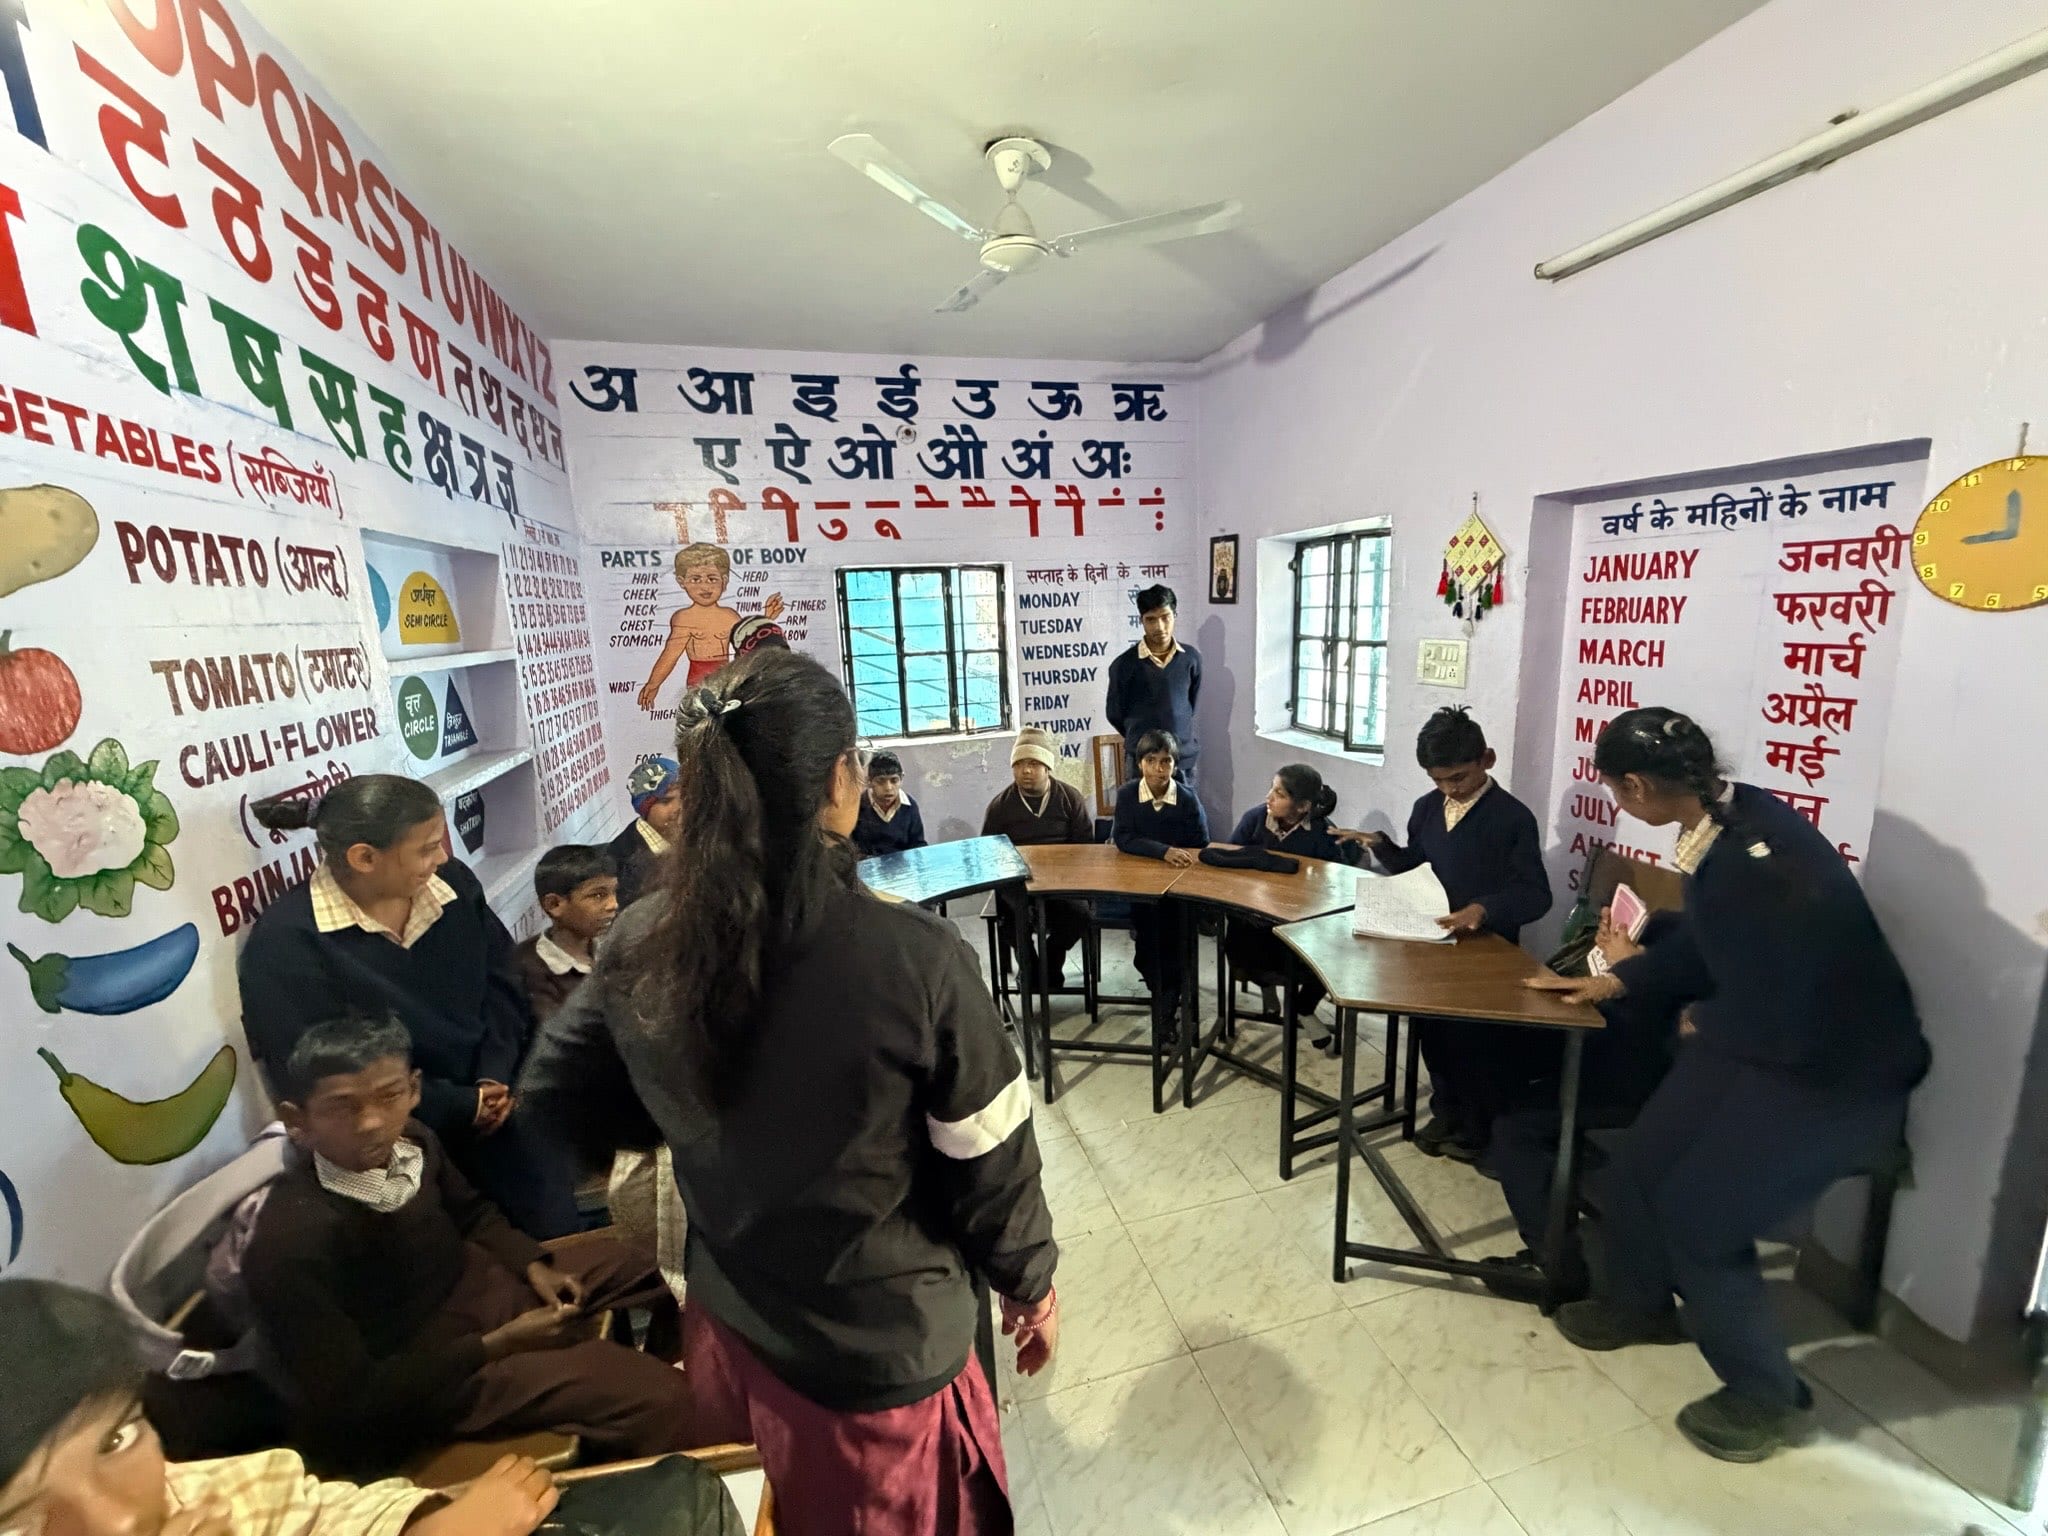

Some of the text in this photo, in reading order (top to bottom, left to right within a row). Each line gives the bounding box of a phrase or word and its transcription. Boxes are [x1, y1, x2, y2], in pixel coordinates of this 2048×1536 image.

[72, 41, 188, 229] ट
[192, 138, 273, 284] ठ
[280, 208, 343, 331] ड
[397, 302, 447, 399] ण
[447, 341, 480, 419] त
[76, 223, 203, 398] श
[207, 296, 295, 431] ष
[298, 345, 368, 463] स
[367, 382, 414, 484] ह
[418, 411, 460, 500] क्ष
[459, 433, 492, 505] त्र
[569, 363, 1168, 425] अ आ इ ई उ ऊ ऋ
[693, 423, 1132, 486] ए ऐ ओ औ अं अः
[2007, 459, 2026, 472] 12
[1963, 475, 1981, 487] 11
[1602, 503, 1643, 535] वर्ष
[1650, 499, 1678, 530] के
[1779, 484, 1811, 518] के
[1819, 481, 1896, 513] नाम
[1931, 500, 1950, 512] 10
[1915, 534, 1926, 545] 9
[114, 521, 269, 588] POTATO
[502, 542, 508, 568] 1
[510, 543, 519, 568] 11
[519, 545, 529, 571] 21
[601, 548, 807, 568] PARTS OF BODY
[1779, 524, 1911, 577] जनवरी
[742, 571, 769, 582] HEAD
[1067, 564, 1078, 583] के
[1117, 562, 1130, 579] के
[1140, 564, 1169, 579] नाम
[1583, 549, 1700, 583] JANUARY
[1923, 567, 1934, 578] 8
[506, 573, 512, 598] 2
[514, 573, 523, 597] 12
[523, 575, 533, 596] 22
[632, 573, 659, 585] HAIR
[623, 588, 658, 601] CHEEK
[736, 587, 760, 598] CHIN
[1019, 591, 1081, 609] MONDAY
[1953, 585, 1963, 596] 7
[1986, 595, 1998, 607] 6
[2034, 587, 2046, 600] 5
[624, 604, 657, 617] NECK
[736, 601, 762, 613] THUMB
[790, 599, 827, 612] FINGERS
[1580, 596, 1688, 625] FEBRUARY
[1773, 579, 1896, 634] फरवरी
[424, 614, 448, 628] CIRCLE
[511, 604, 517, 629] 3
[519, 604, 527, 629] 13
[528, 604, 537, 629] 23
[620, 619, 655, 632] CHEST
[785, 615, 807, 626] ARM
[1020, 618, 1083, 635] TUESDAY
[517, 635, 523, 660] 4
[524, 633, 533, 660] 14
[533, 632, 542, 657] 24
[609, 634, 663, 648] STOMACH
[1021, 641, 1108, 660] WEDNESDAY
[1579, 639, 1665, 668] MARCH
[1783, 632, 1866, 679] मार्च
[150, 651, 296, 716] TOMATO
[522, 665, 529, 690] 5
[529, 664, 537, 688] 15
[537, 663, 546, 686] 25
[1022, 667, 1098, 686] THURSDAY
[609, 681, 637, 694] WRIST
[1577, 678, 1640, 708] APRIL
[526, 690, 551, 720] 6 16 26
[1025, 694, 1070, 711] FRIDAY
[1762, 683, 1858, 735] अप्रैल
[404, 715, 435, 738] CIRCLE
[530, 723, 537, 749] 7
[538, 720, 545, 745] 17
[546, 717, 554, 742] 27
[179, 707, 380, 789] CAULI-FLOWER
[1765, 735, 1840, 788] मई
[1570, 794, 1621, 827] JULY
